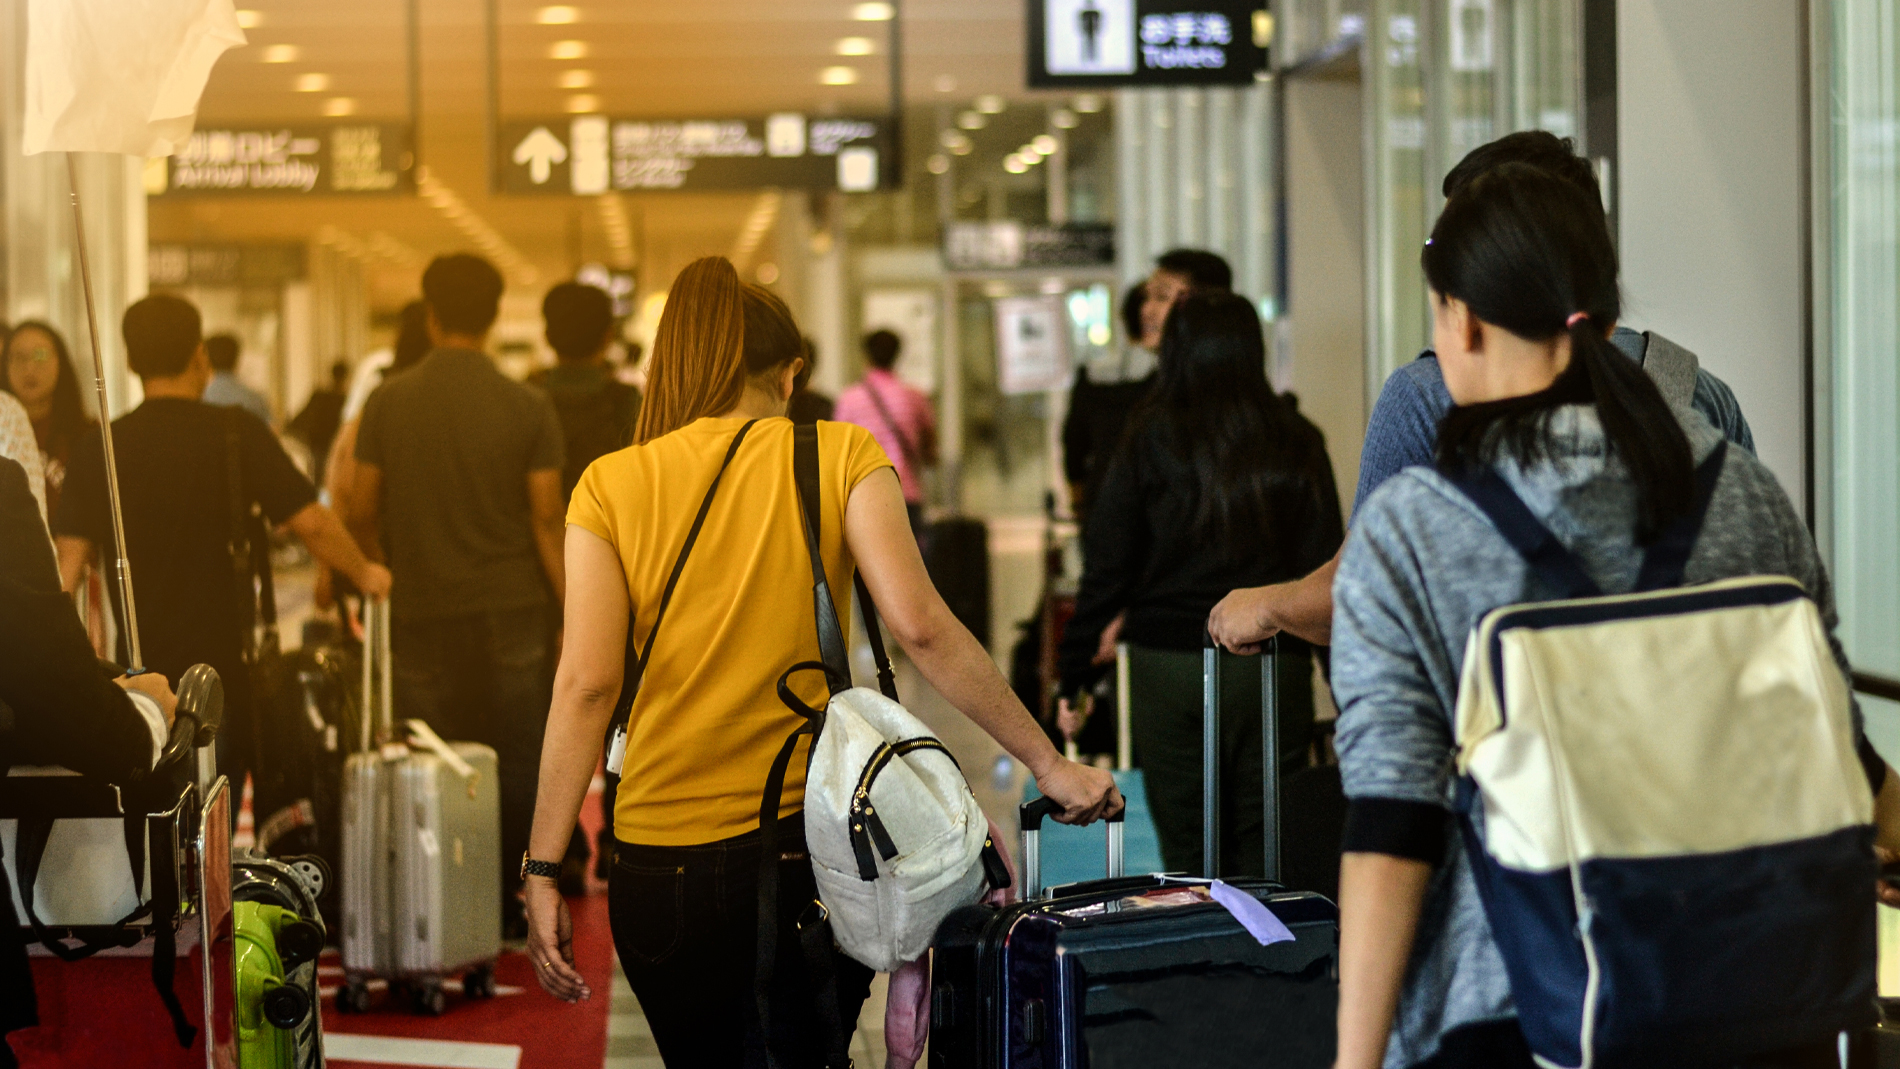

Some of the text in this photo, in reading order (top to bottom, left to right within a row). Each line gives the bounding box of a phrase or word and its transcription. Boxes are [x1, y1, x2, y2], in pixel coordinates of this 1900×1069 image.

[1143, 45, 1226, 68] Toilets
[174, 163, 319, 191] Arrival Lobby
